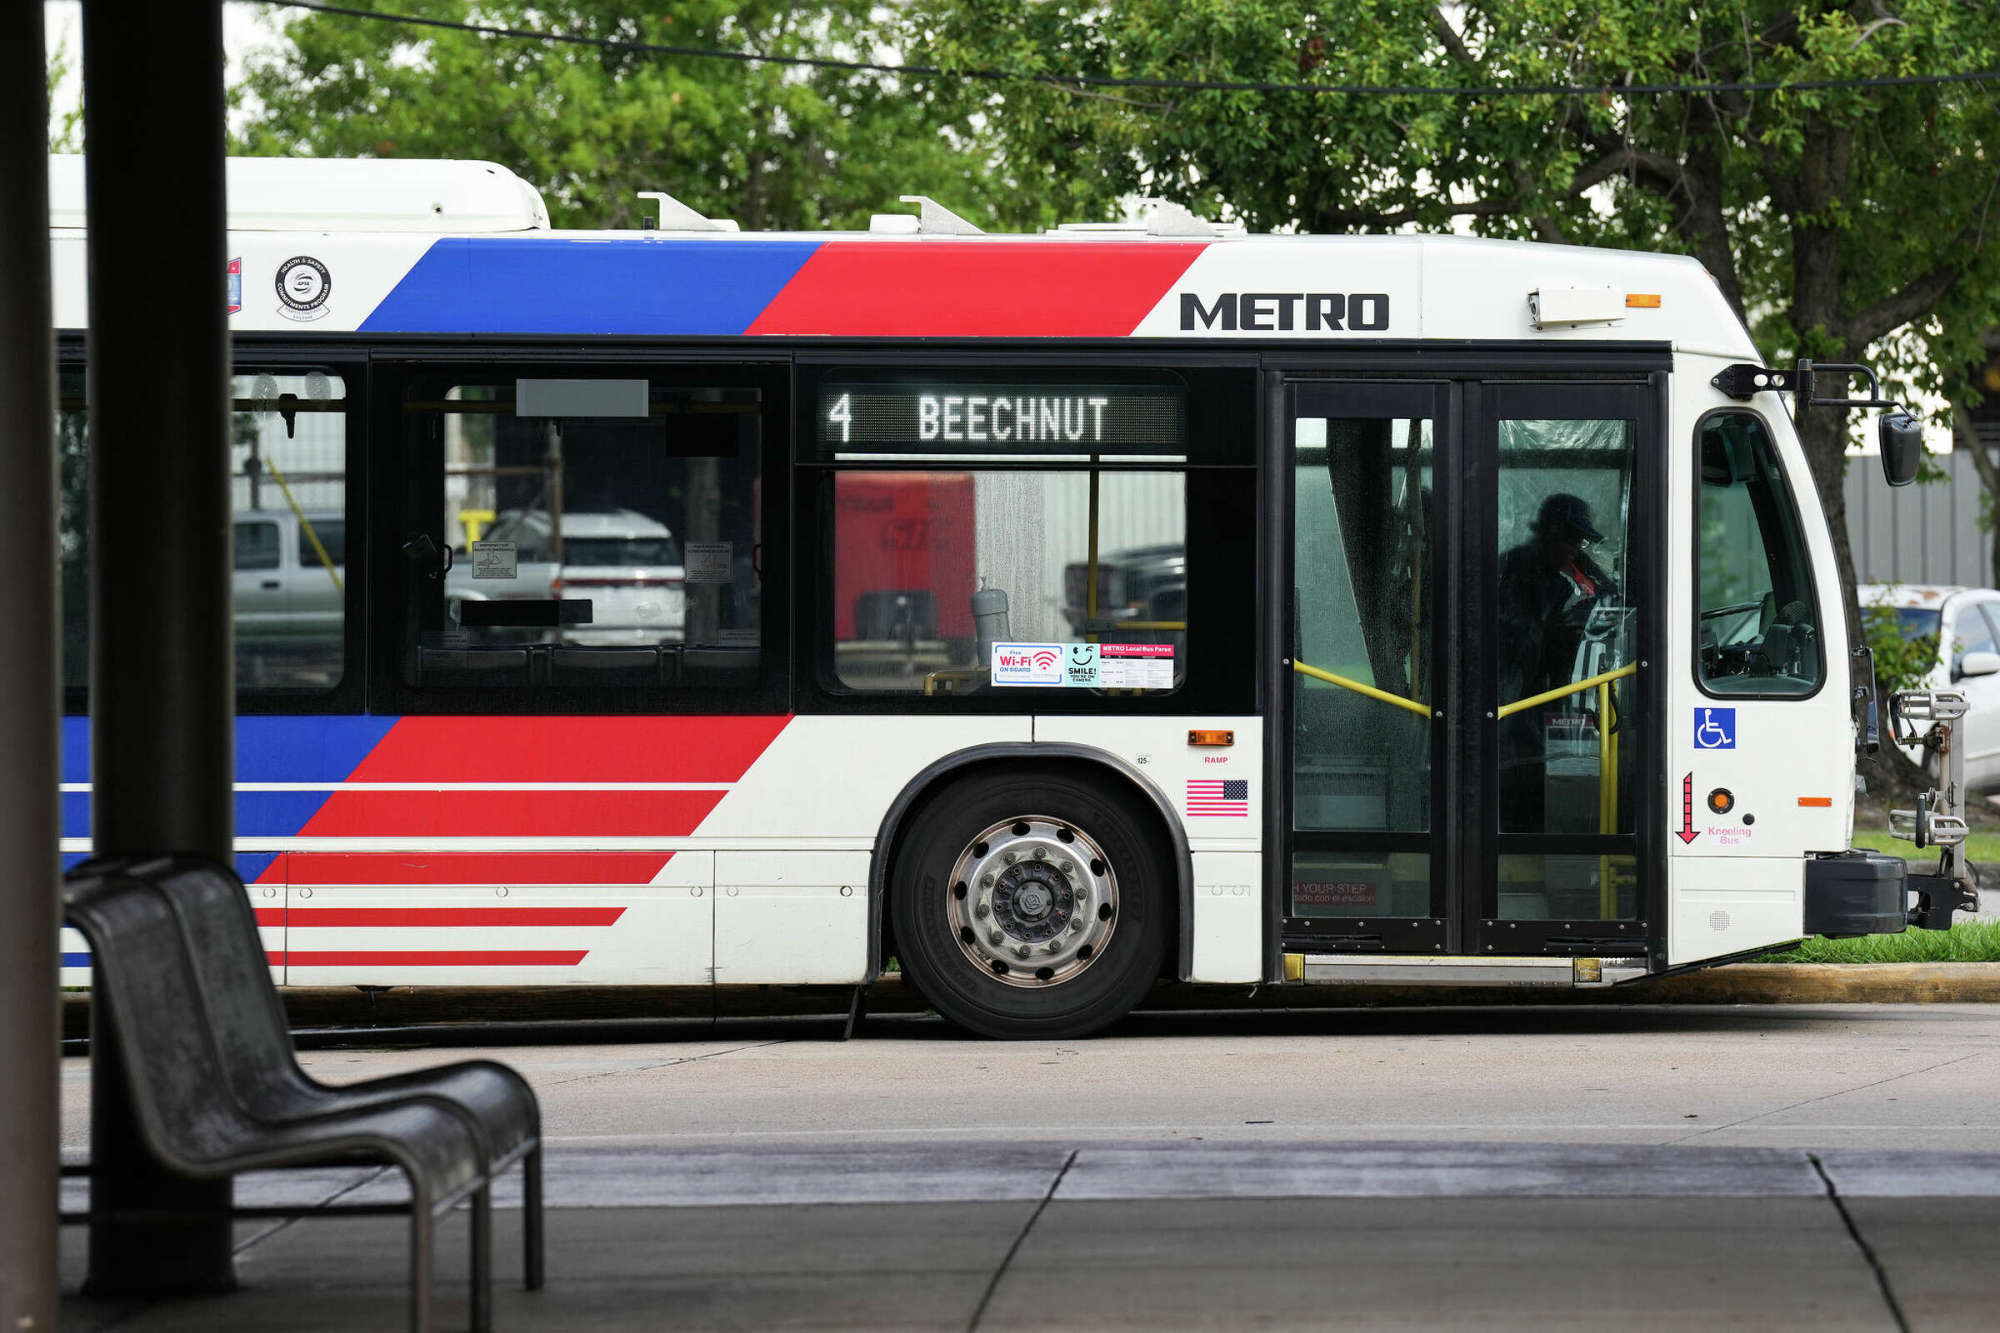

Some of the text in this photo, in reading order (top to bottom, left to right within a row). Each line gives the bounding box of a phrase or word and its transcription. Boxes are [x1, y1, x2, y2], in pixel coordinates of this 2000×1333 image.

[281, 258, 301, 273] HEALTH
[307, 258, 326, 274] SAFETY
[277, 282, 329, 310] COMMITMENTS PROGRAM
[1180, 293, 1390, 331] METRO
[829, 393, 1109, 442] 4 BEECHNUT
[999, 655, 1032, 667] Wi-Fi
[1068, 667, 1097, 675] SMILE!
[1204, 756, 1228, 764] RAMP
[1708, 827, 1752, 837] Kneeling
[1719, 836, 1740, 845] Bus
[1303, 883, 1335, 894] YOUR
[1336, 883, 1368, 894] STEP
